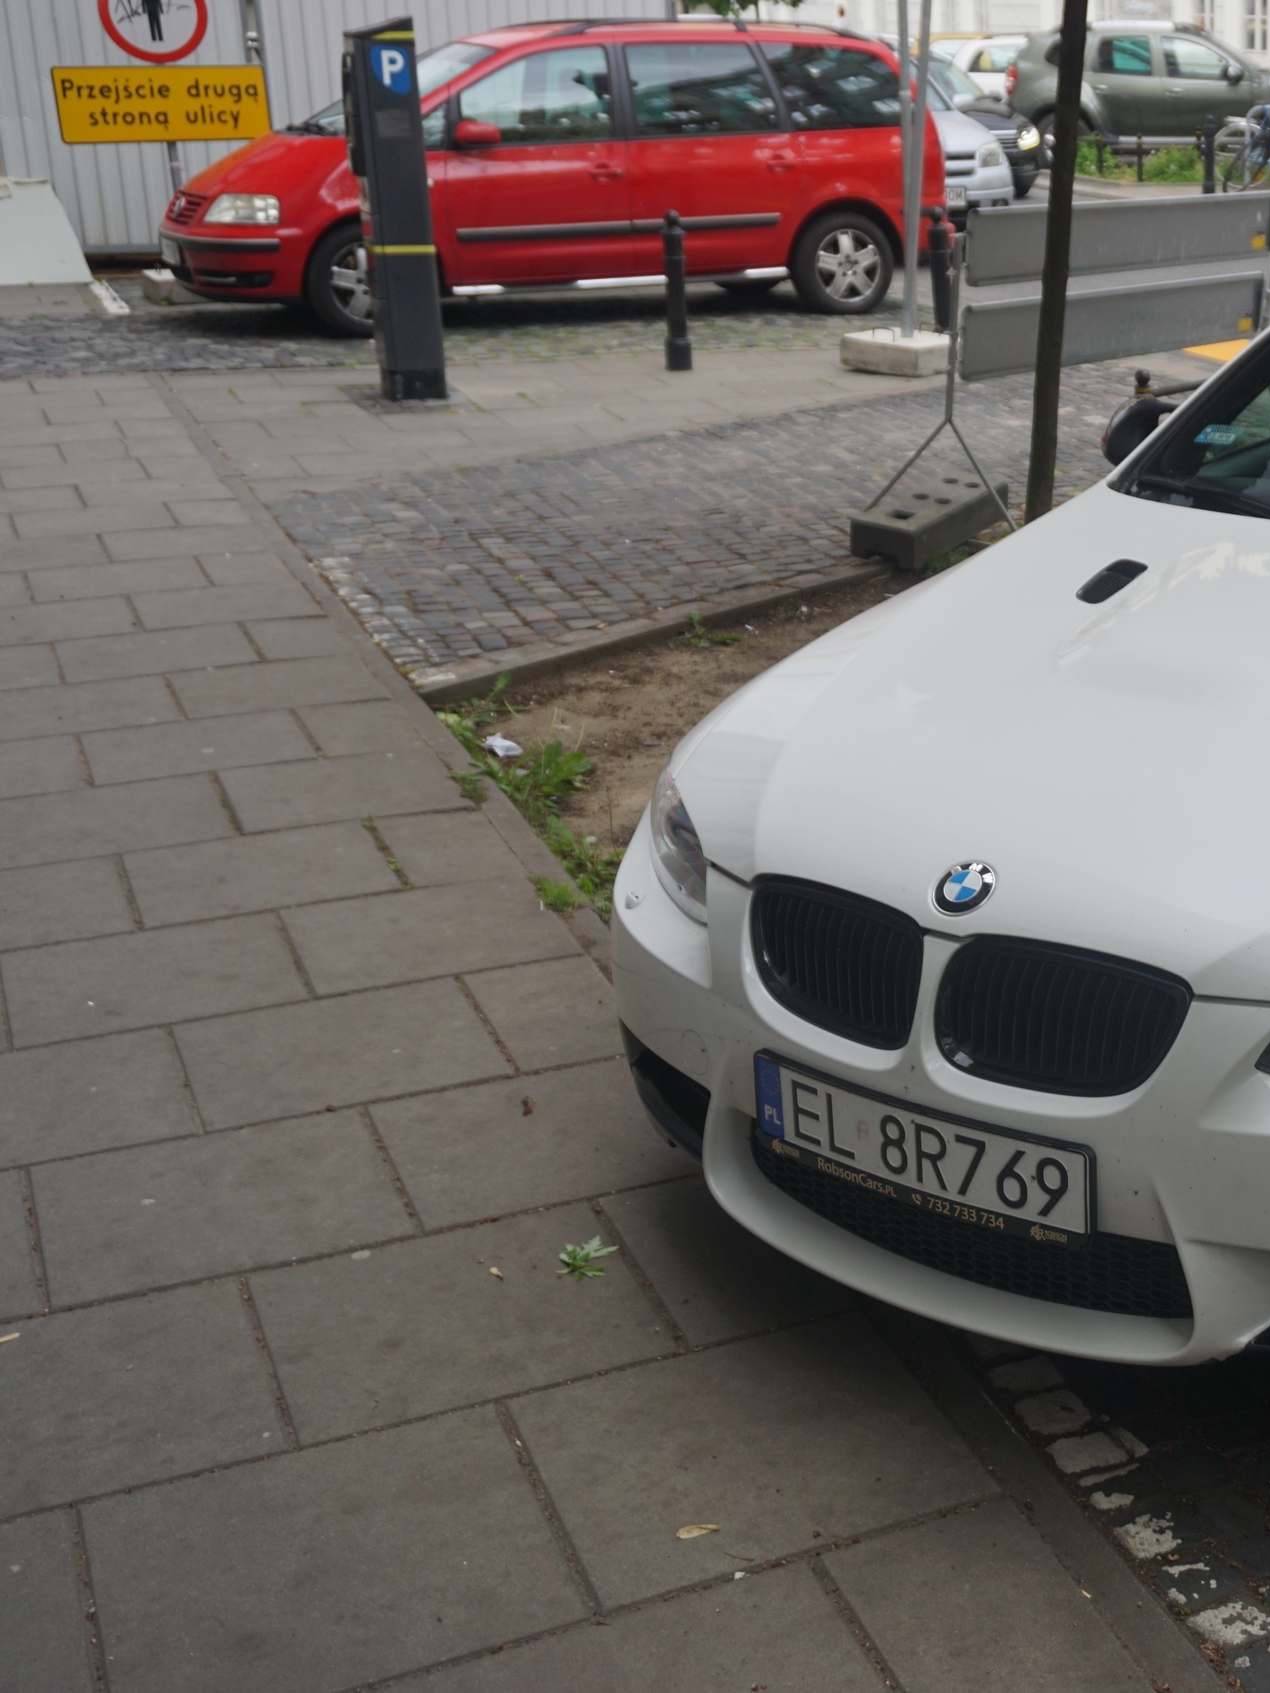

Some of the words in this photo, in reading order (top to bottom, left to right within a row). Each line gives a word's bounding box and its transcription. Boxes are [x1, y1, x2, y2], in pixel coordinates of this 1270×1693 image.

[380, 49, 405, 87] P
[60, 78, 171, 104] Przejście
[186, 78, 259, 104] drugą
[88, 105, 170, 130] stroną
[185, 104, 241, 129] ulicy
[950, 862, 994, 884] BMW
[764, 1103, 781, 1126] PL
[791, 1078, 856, 1161] EL
[879, 1114, 1069, 1218] 8R769
[816, 1156, 897, 1198] RobsonCars.PL
[927, 1197, 951, 1215] 732
[953, 1204, 977, 1222] 733
[980, 1212, 1005, 1229] 734
